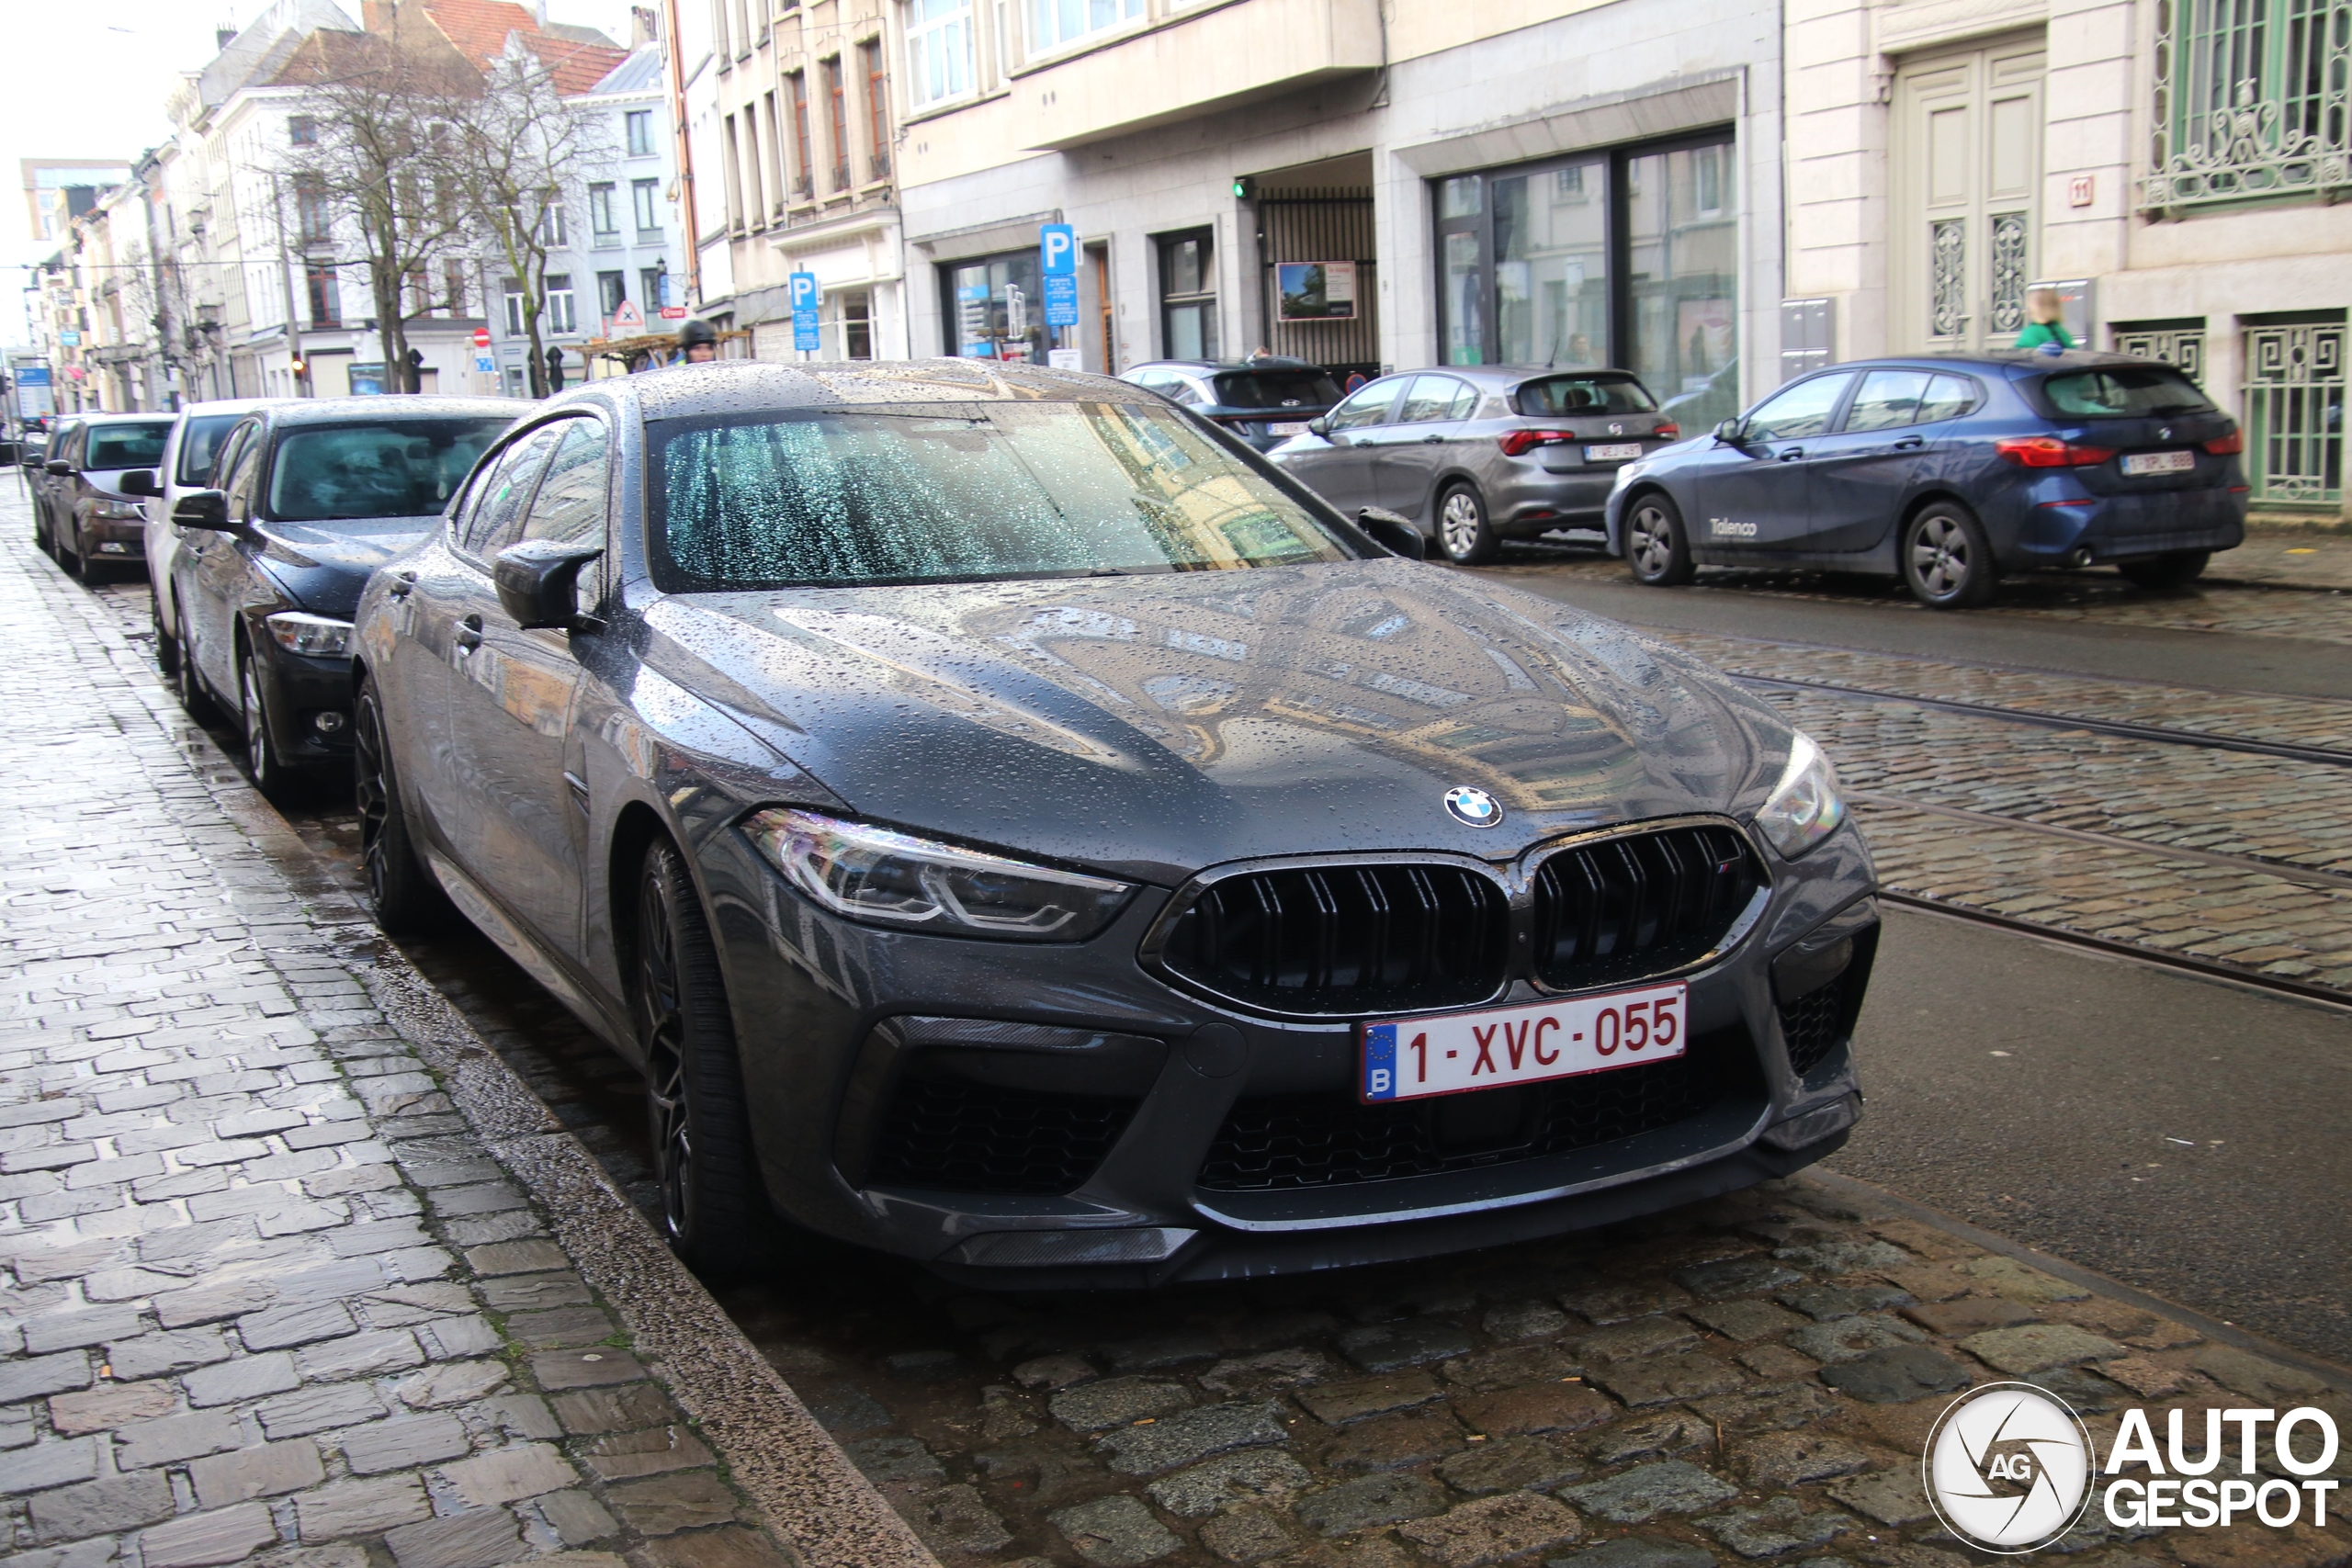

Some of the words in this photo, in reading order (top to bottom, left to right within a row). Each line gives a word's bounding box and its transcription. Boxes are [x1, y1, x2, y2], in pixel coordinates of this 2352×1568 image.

[2075, 183, 2089, 199] 11
[1046, 231, 1069, 267] P
[793, 277, 812, 306] P
[1710, 516, 1757, 536] Talenco
[1410, 997, 1678, 1083] 1-XVC-055
[1371, 1068, 1391, 1092] B
